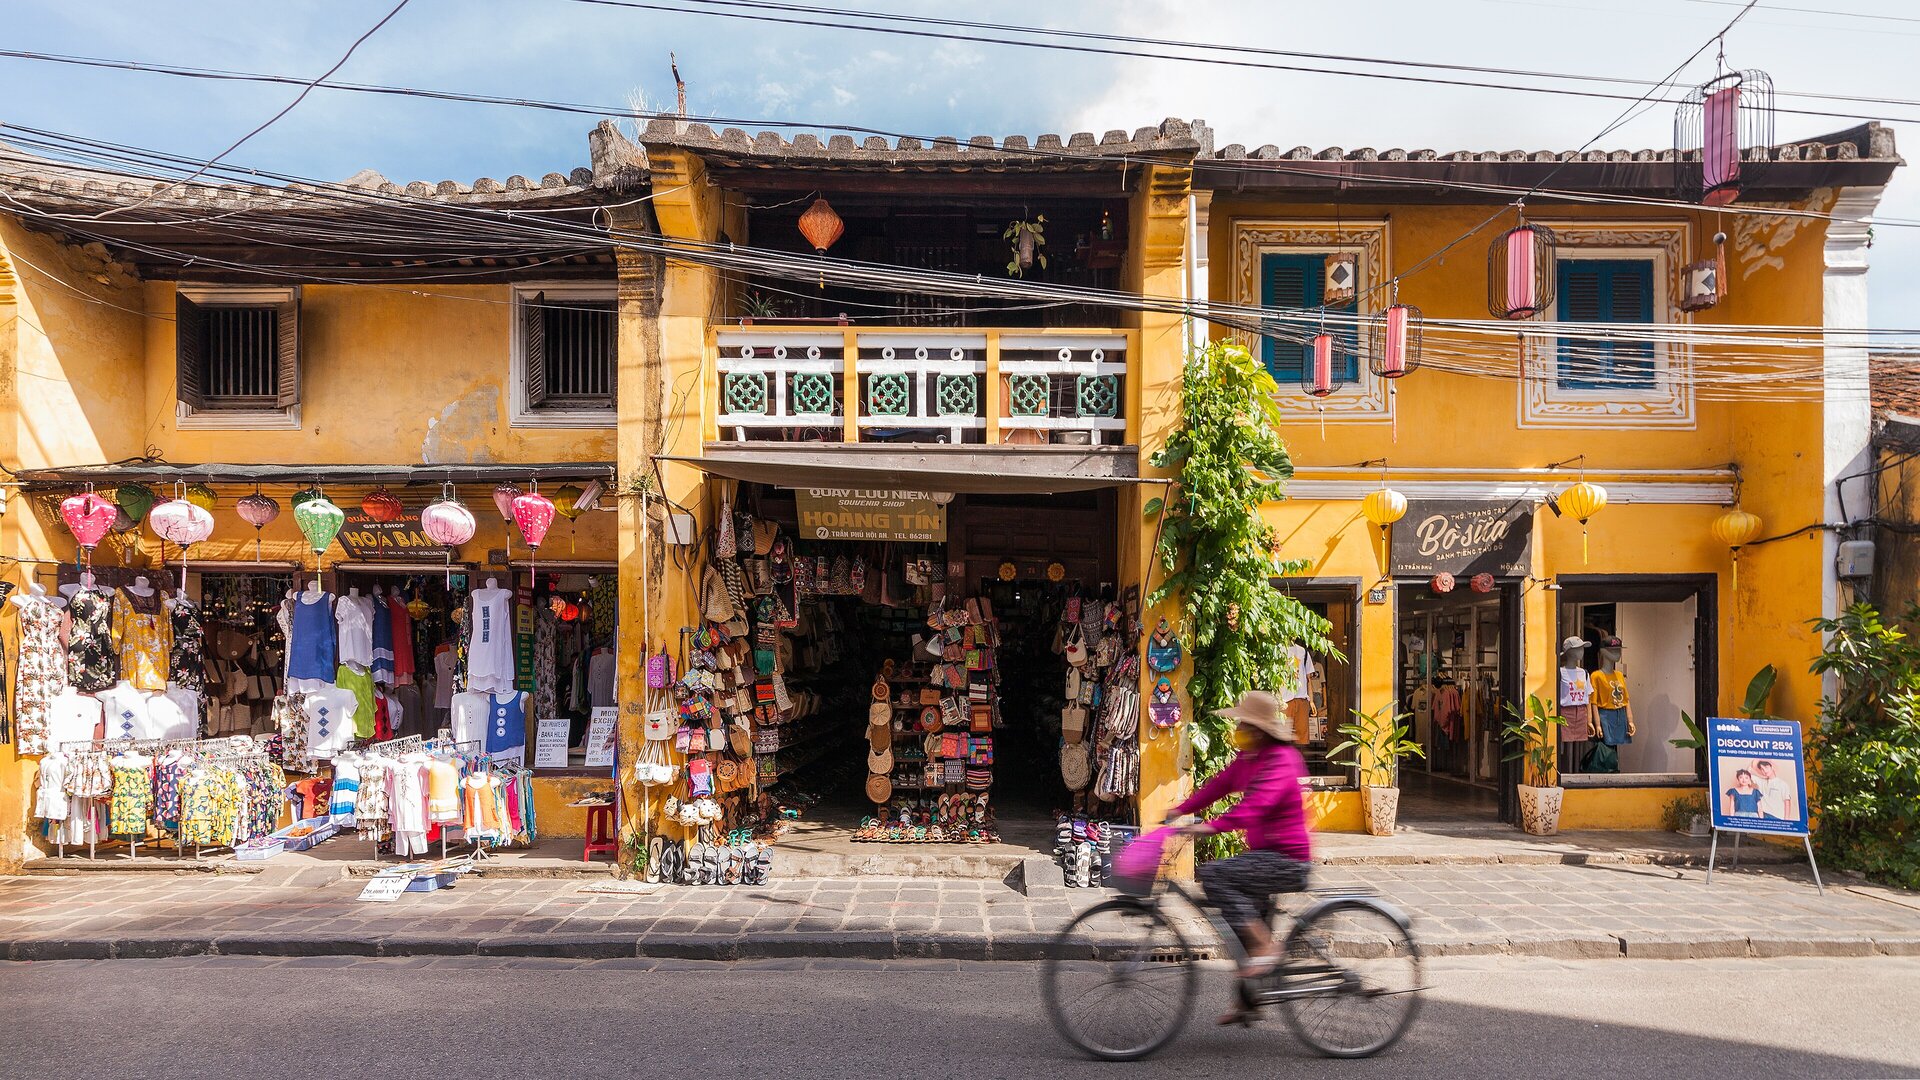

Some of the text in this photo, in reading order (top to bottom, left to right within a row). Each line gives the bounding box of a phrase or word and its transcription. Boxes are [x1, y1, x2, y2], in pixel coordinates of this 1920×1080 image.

[838, 499, 880, 507] SOUVENIR
[803, 506, 939, 530] HOÀNG TÍN
[1717, 738, 1794, 751] DISCOUNT 25%
